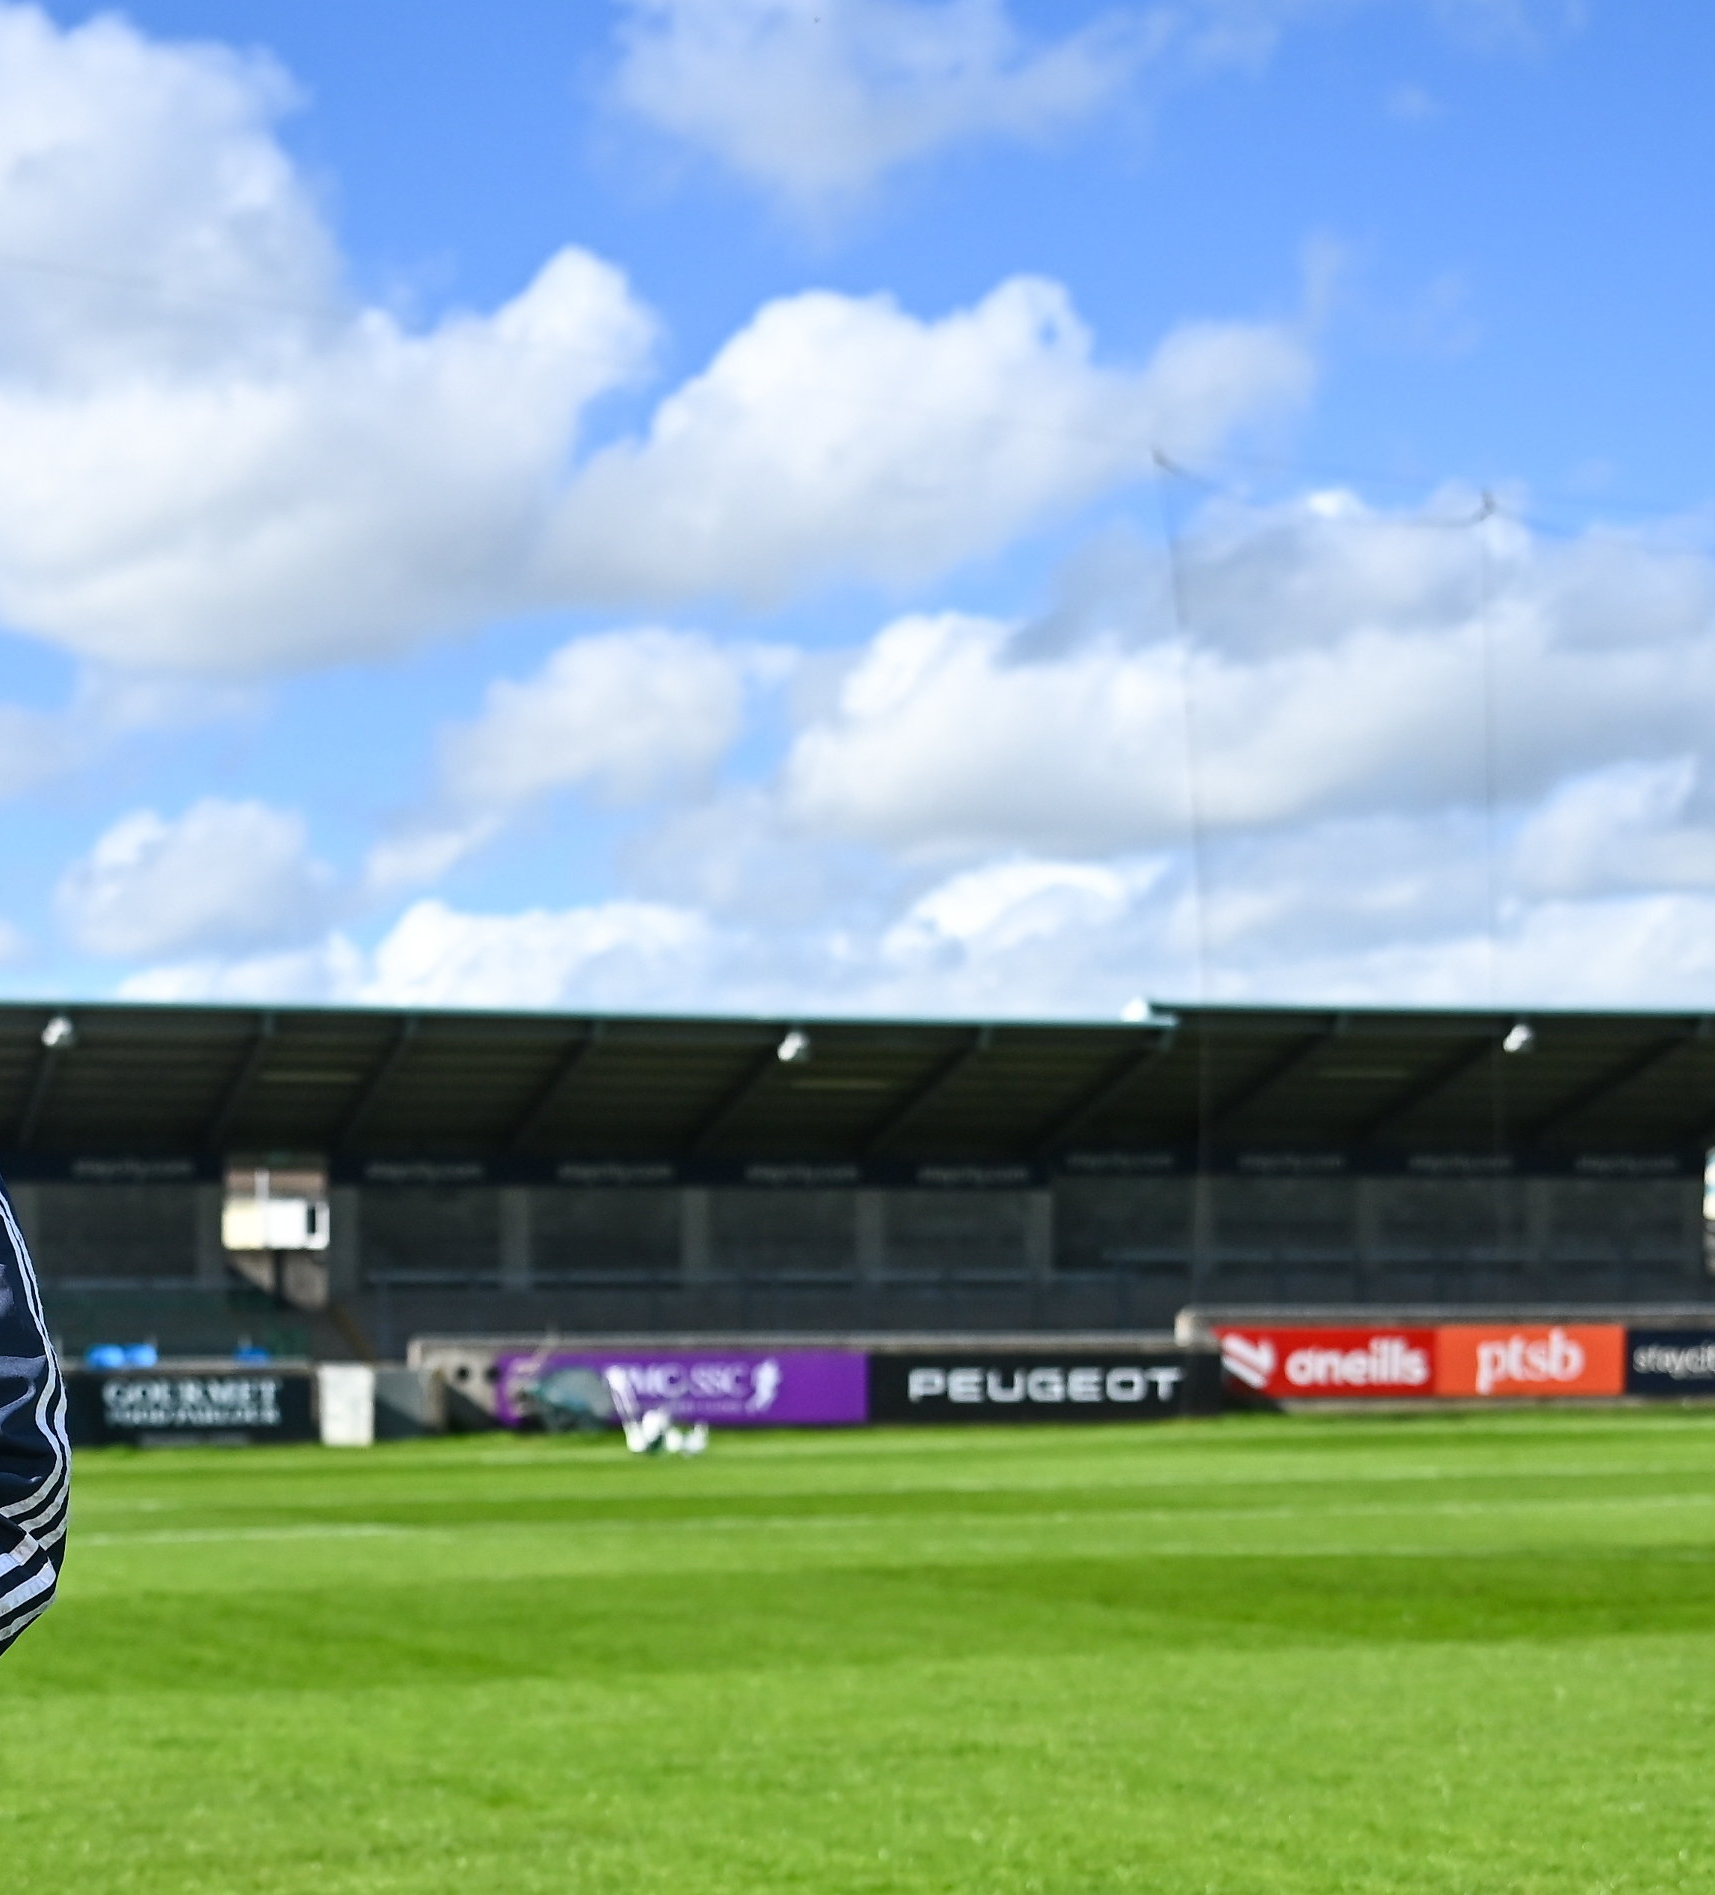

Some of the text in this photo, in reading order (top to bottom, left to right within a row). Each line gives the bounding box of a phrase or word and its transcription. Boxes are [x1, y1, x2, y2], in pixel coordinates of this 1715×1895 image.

[1475, 1327, 1585, 1394] ptsb
[103, 1380, 279, 1407] GOURMET
[907, 1366, 1183, 1403] PEUGEOT
